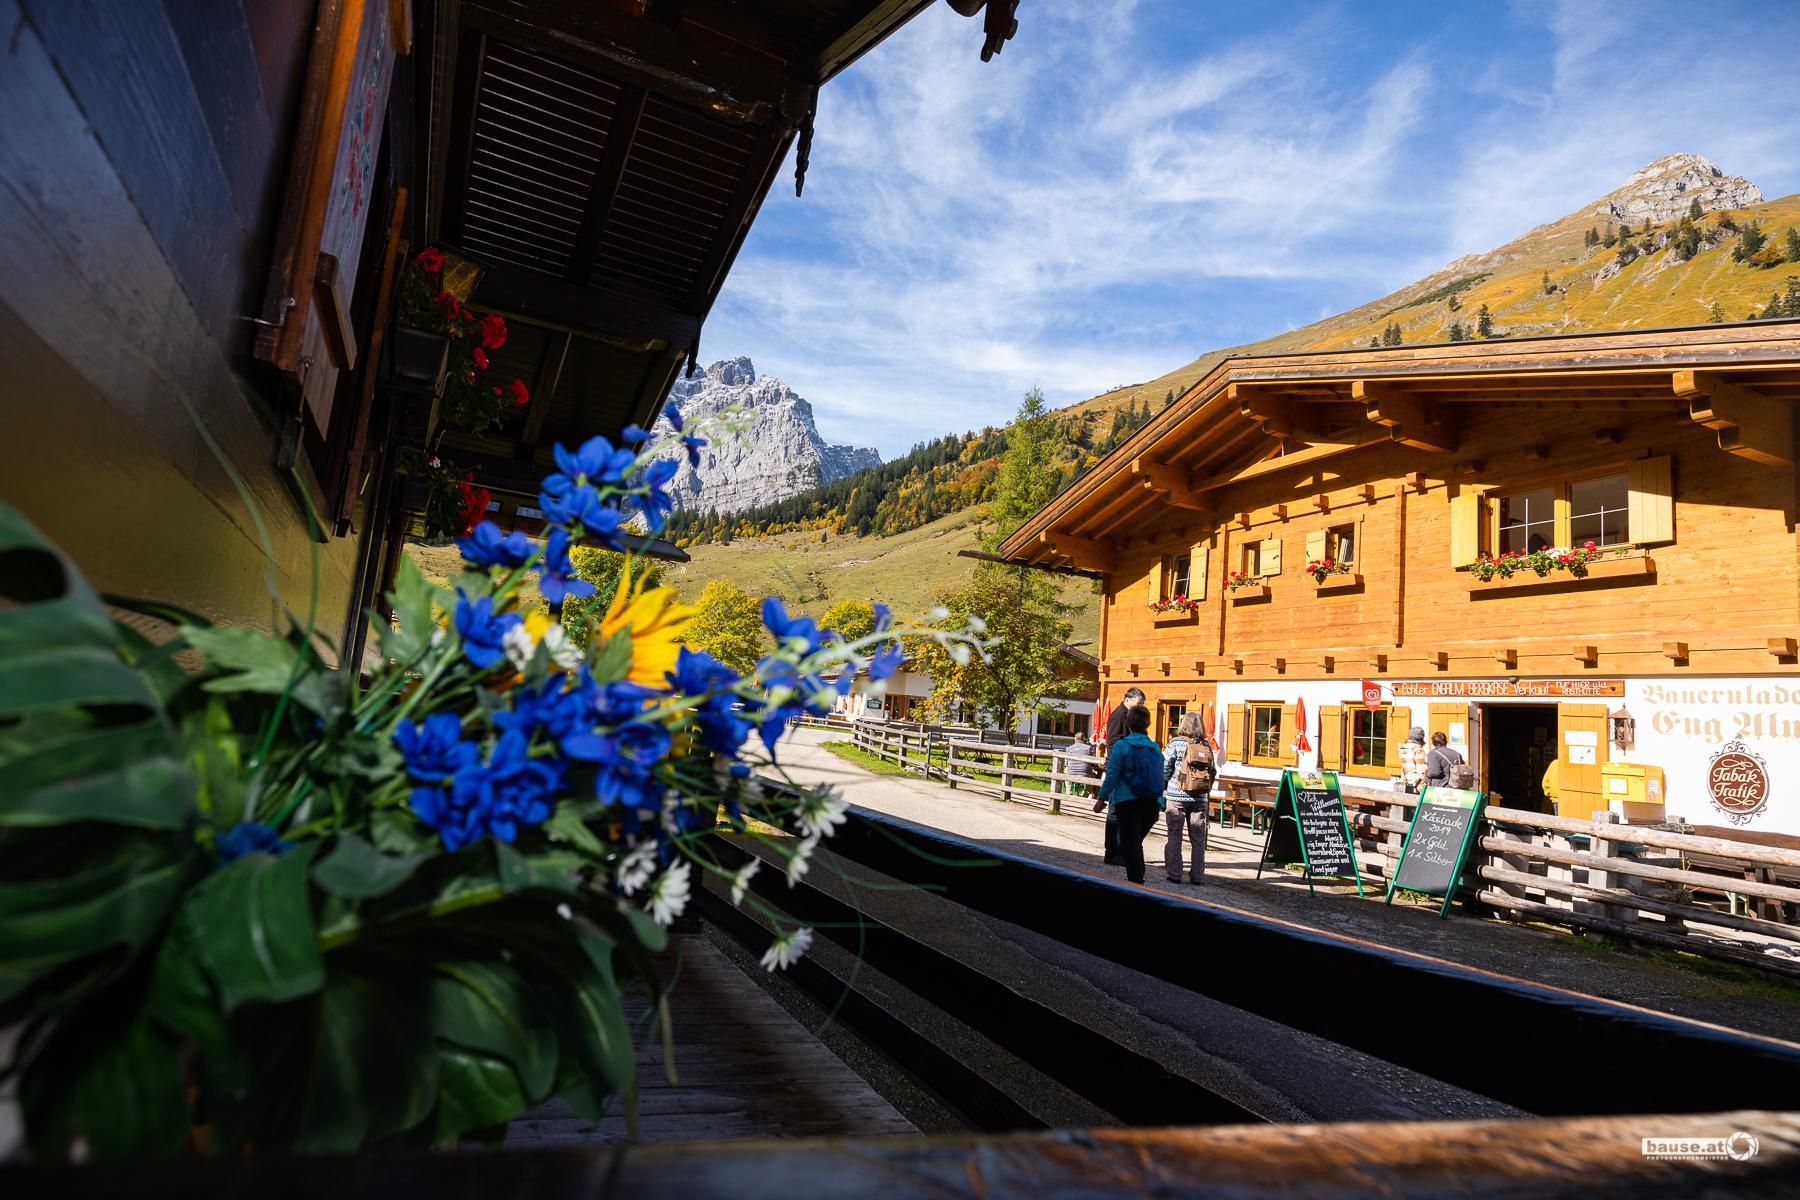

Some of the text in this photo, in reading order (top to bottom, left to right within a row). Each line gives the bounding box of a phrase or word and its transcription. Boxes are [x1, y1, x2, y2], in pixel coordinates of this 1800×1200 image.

[1514, 682, 1549, 696] Verkauf
[1652, 710, 1723, 744] Eng
[1712, 767, 1761, 784] Tabak
[1713, 783, 1762, 801] Trafik
[1421, 811, 1463, 829] Käsiade
[1428, 824, 1452, 835] 2019
[1427, 836, 1449, 850] Gold
[1423, 851, 1453, 865] Silber
